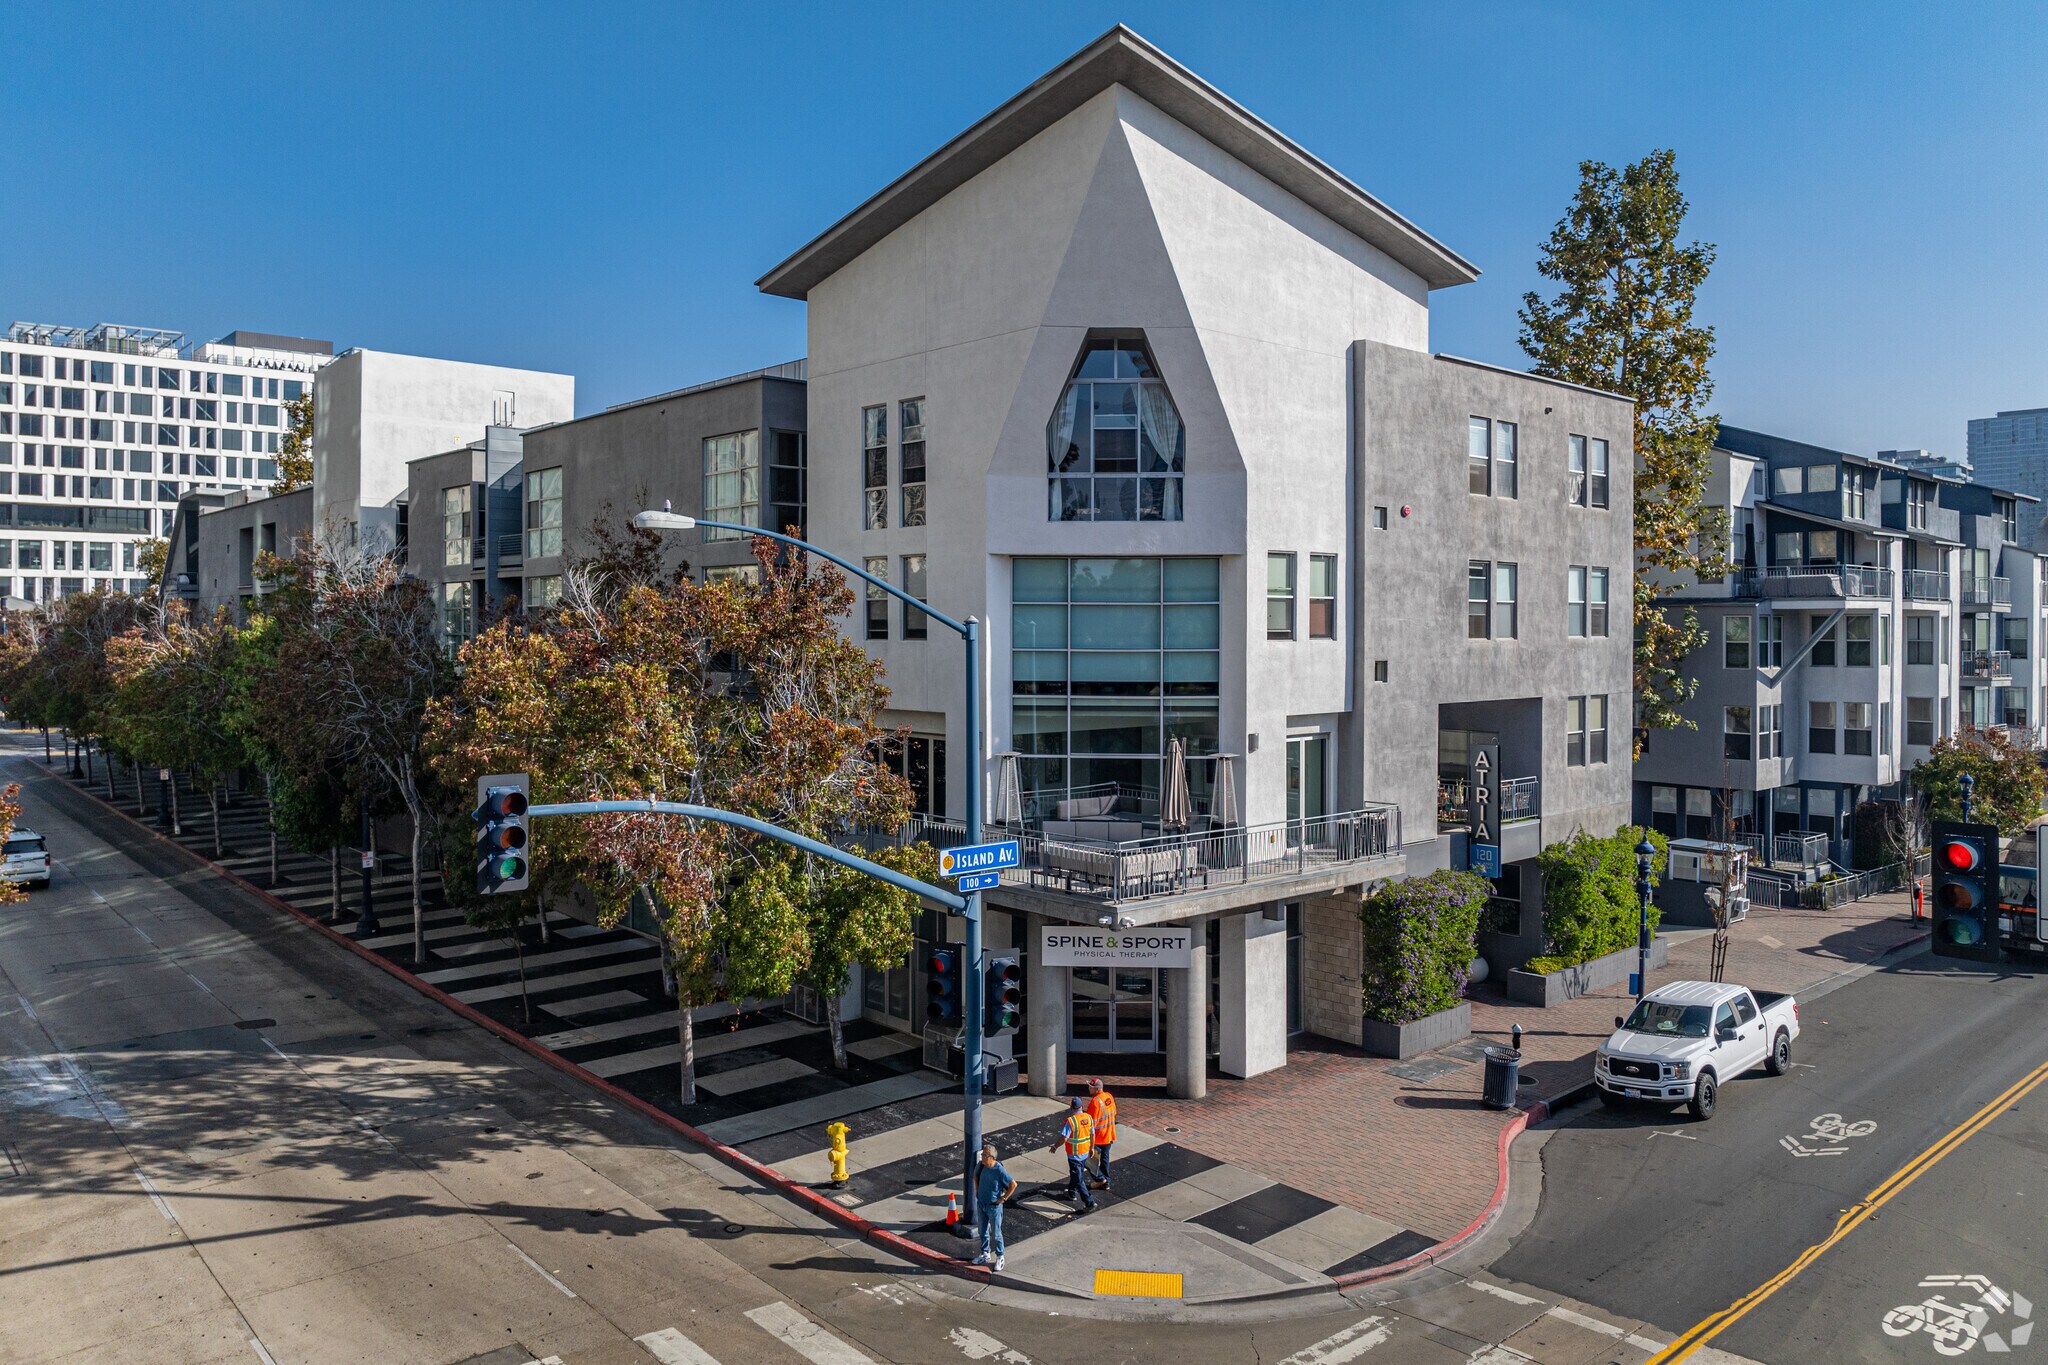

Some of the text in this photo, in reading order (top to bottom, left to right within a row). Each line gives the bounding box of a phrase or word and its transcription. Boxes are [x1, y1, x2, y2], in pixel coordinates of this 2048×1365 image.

[1474, 750, 1490, 840] ATRIA
[1476, 848, 1493, 862] 120
[966, 877, 980, 889] 100
[1047, 935, 1186, 949] SPINE & SPORT
[1073, 950, 1116, 958] PHYSICAL
